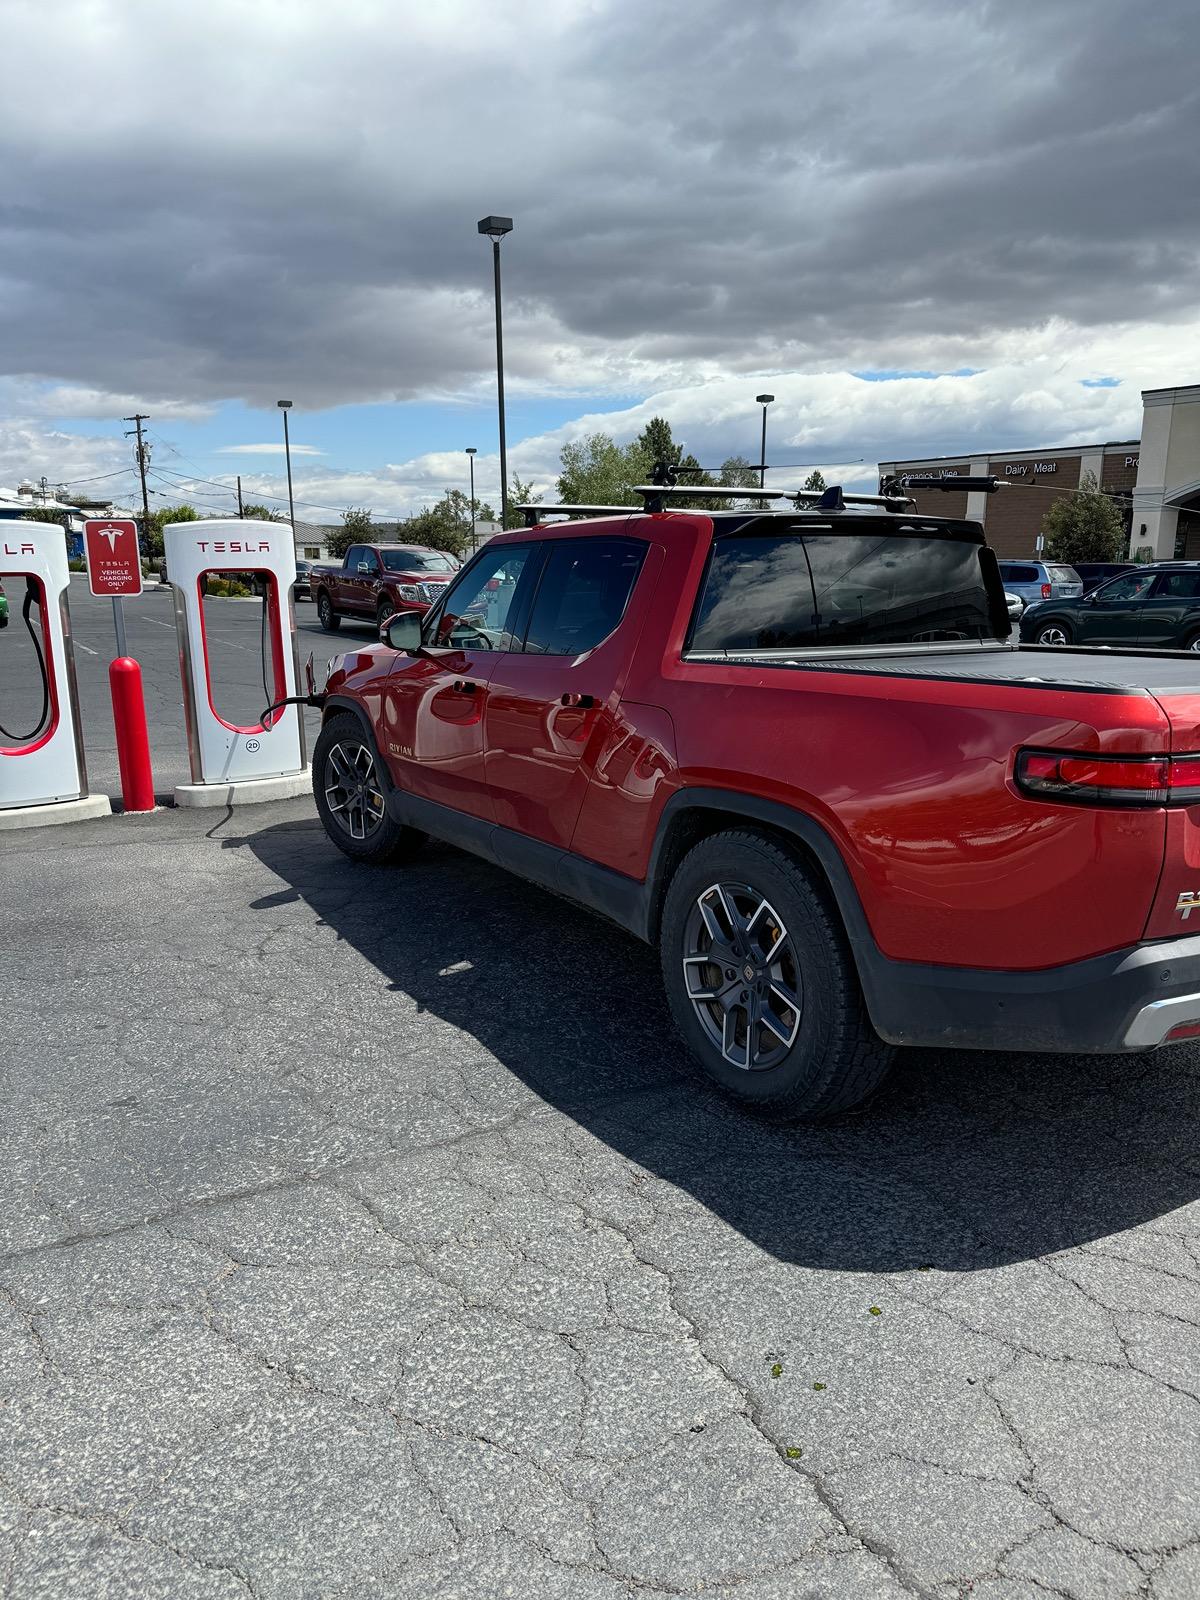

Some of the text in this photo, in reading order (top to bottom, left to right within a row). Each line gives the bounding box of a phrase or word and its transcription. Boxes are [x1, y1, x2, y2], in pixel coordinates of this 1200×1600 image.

[938, 469, 958, 479] Wine
[1005, 462, 1056, 476] Dairy Meat
[196, 542, 270, 553] TESLA
[389, 742, 412, 756] RIVIAN
